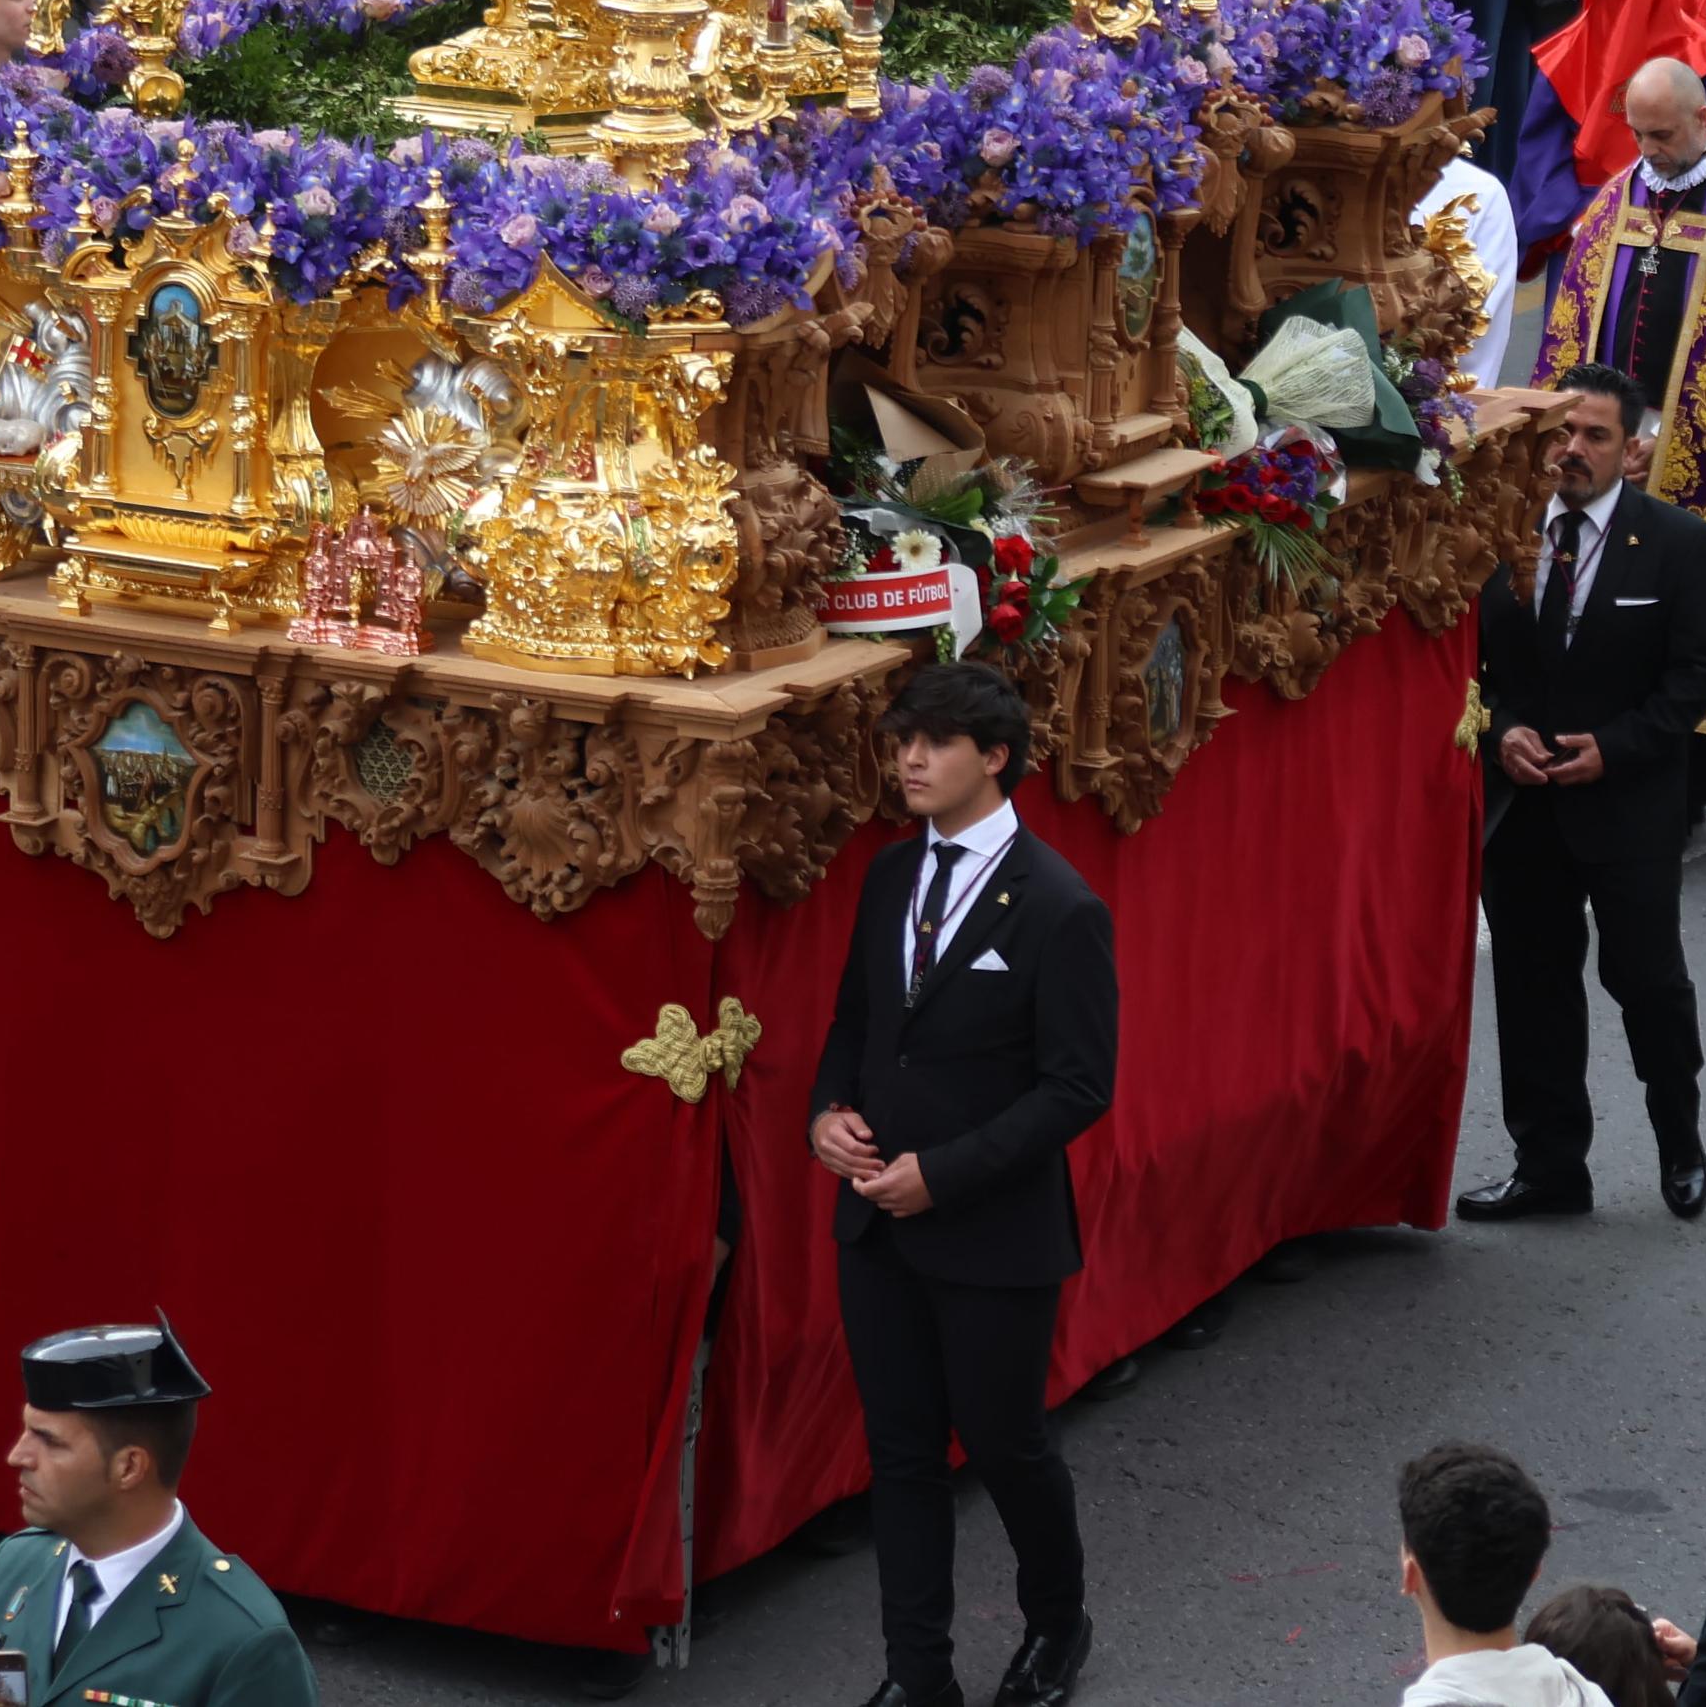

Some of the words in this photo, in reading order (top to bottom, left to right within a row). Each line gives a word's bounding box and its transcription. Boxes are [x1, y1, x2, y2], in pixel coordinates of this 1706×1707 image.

[834, 592, 878, 610] CLUB
[883, 591, 905, 608] DE
[908, 582, 950, 605] FÚTBOL
